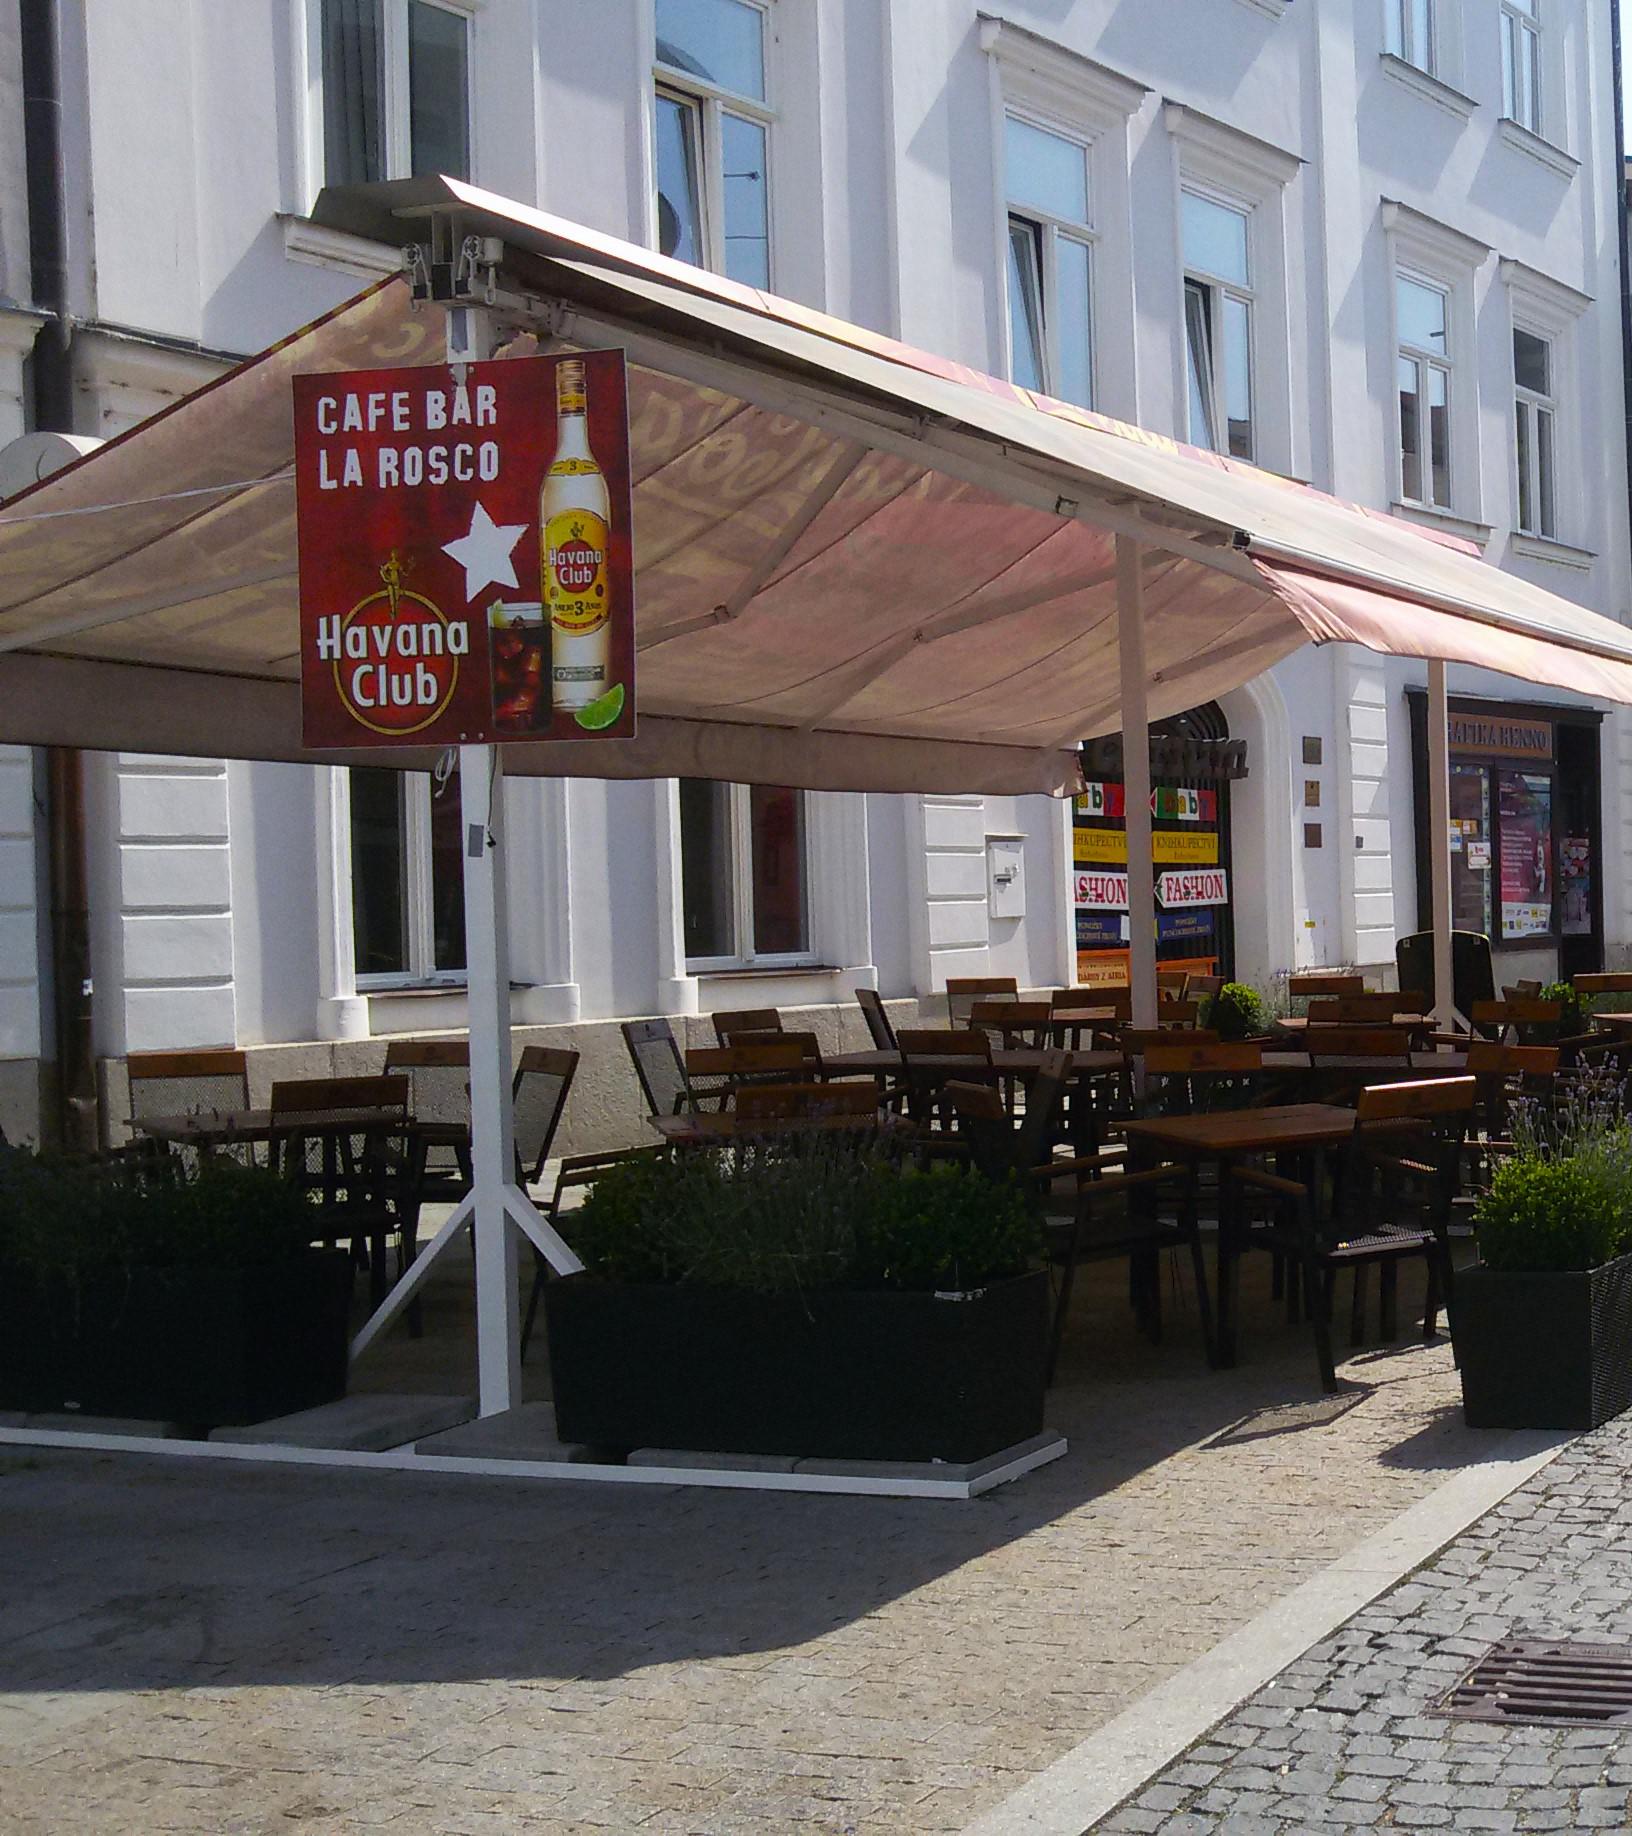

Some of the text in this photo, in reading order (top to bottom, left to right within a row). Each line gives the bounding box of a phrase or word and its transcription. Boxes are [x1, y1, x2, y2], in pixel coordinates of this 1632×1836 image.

[317, 384, 498, 434] CAFE BAR
[319, 441, 499, 490] LA ROSCO
[549, 548, 603, 566] Havana
[560, 566, 593, 585] Club
[574, 601, 584, 616] 3
[317, 614, 470, 661] Havana
[352, 663, 438, 708] Club
[1165, 874, 1225, 903] FASHION
